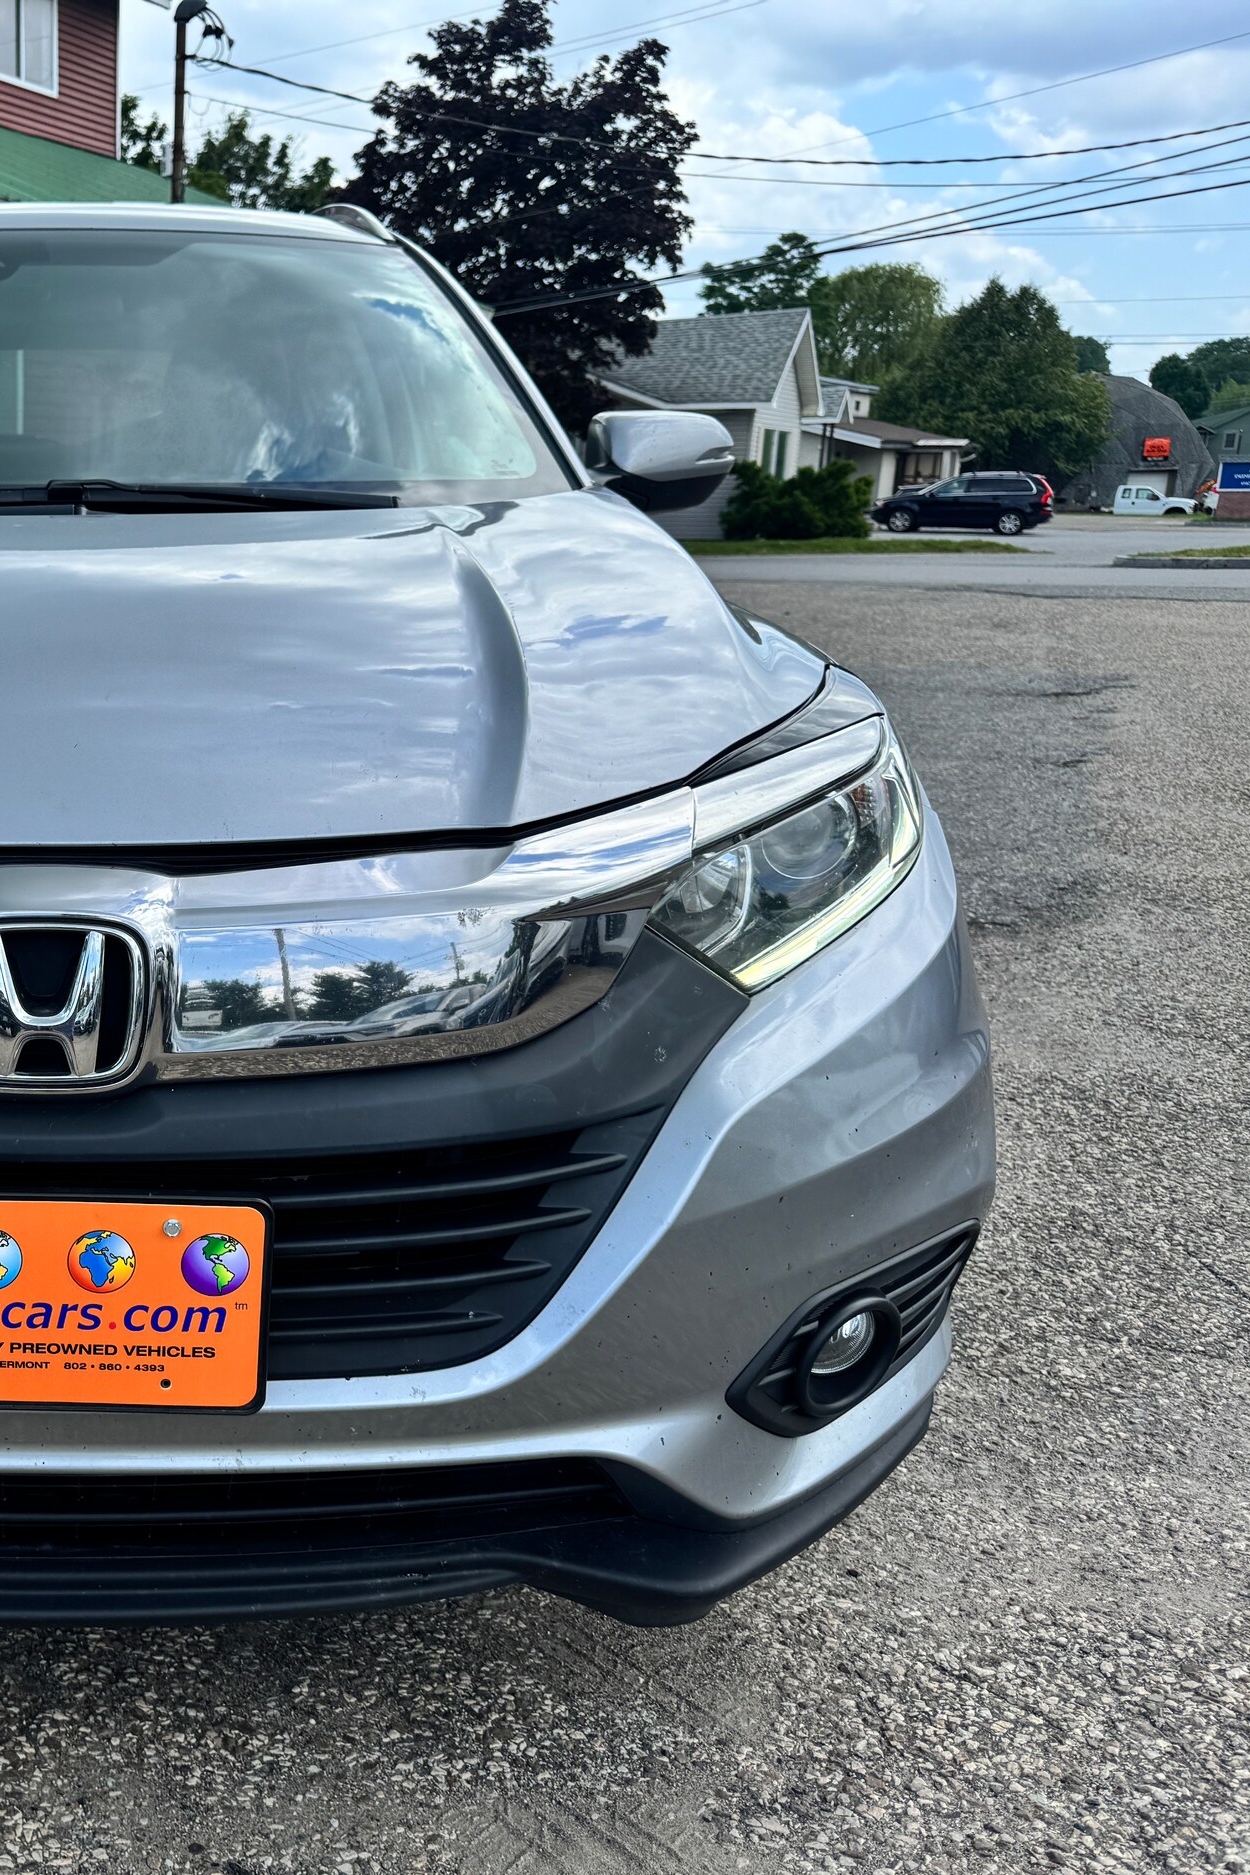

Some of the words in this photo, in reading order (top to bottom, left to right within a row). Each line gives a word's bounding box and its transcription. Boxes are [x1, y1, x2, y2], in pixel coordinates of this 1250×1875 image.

[10, 1343, 118, 1355] PREOWNED
[123, 1345, 216, 1358] VEHICLES
[63, 1362, 87, 1371] 802
[98, 1363, 122, 1372] 860
[133, 1364, 165, 1373] 4393
